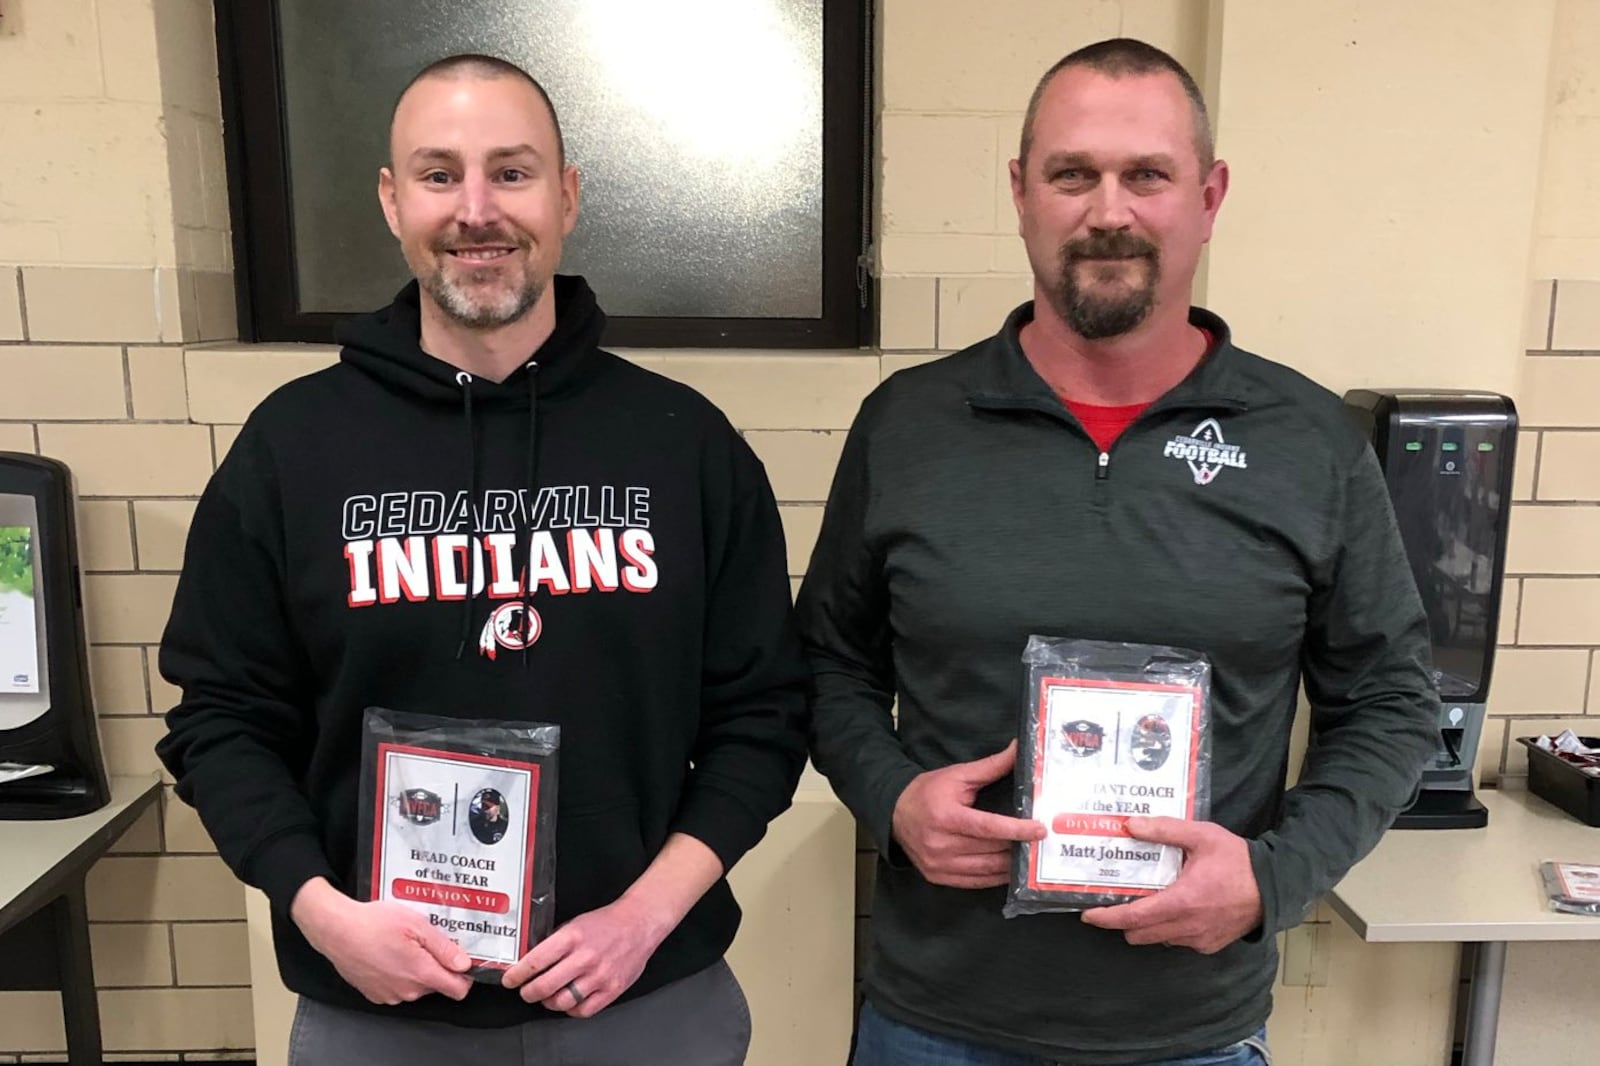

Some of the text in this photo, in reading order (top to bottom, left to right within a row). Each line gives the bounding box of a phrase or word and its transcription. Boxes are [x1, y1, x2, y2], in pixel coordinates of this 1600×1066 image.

[1163, 440, 1247, 469] FOOTBALL
[342, 485, 650, 540] CEDARVILLE
[343, 527, 658, 608] INDIANS
[1129, 785, 1175, 798] COACH
[1092, 800, 1113, 812] the
[1115, 801, 1151, 814] YEAR
[1065, 819, 1123, 831] DIVISIO
[1060, 844, 1096, 858] Matt
[450, 855, 496, 871] COACH
[415, 868, 489, 887] of the YEAR
[405, 885, 496, 907] DIVISION VII
[429, 913, 517, 937] Bogenshutz
